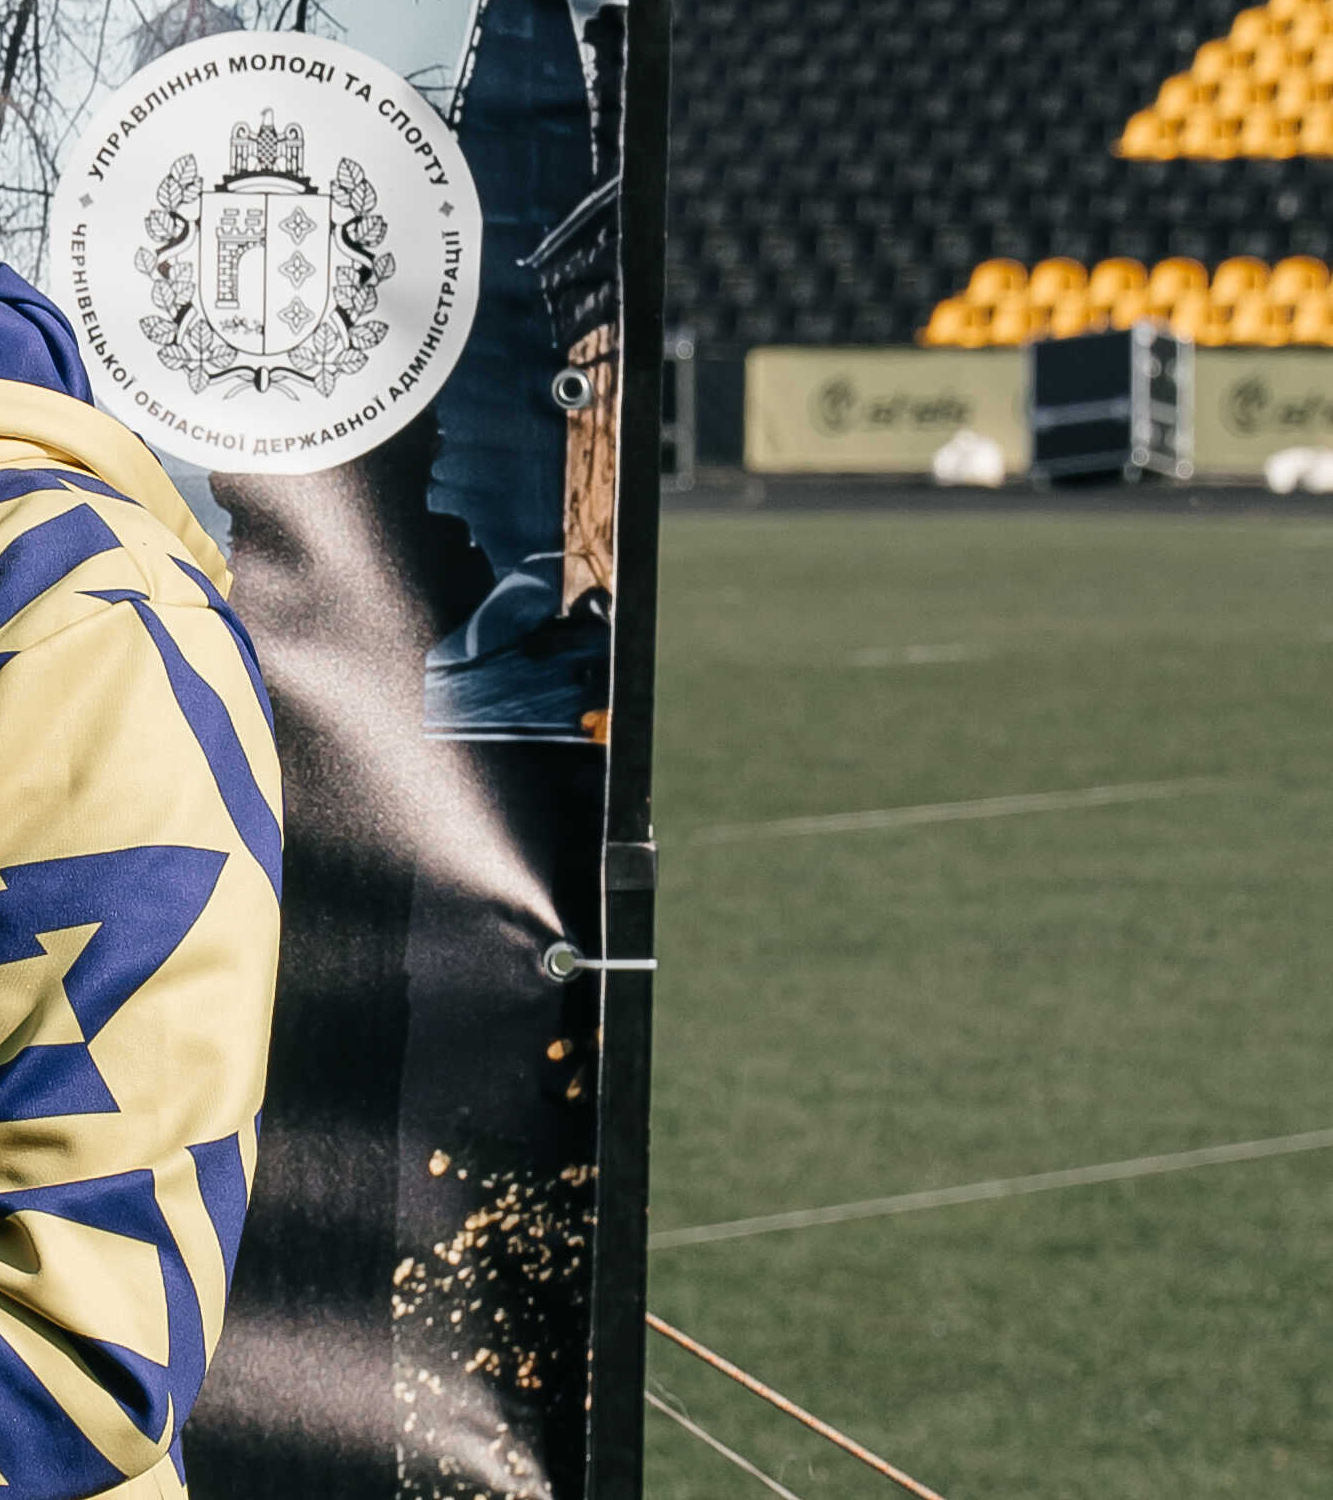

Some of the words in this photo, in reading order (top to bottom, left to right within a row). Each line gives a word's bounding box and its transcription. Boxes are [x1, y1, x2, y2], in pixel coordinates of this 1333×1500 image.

[87, 62, 220, 183] УПРАВЛІННЯ
[228, 53, 337, 84] МОЛОДІ
[343, 72, 371, 103] ТА
[378, 97, 451, 189] СПОРТУ
[70, 223, 136, 393] ЧЕРНІВЕЦЬКОЇ
[134, 391, 245, 454] ОБЛАСНОЇ
[253, 396, 387, 457] ДЕРЖАВНОЇ
[388, 229, 465, 404] АДМІНІСТРАЦІЇ
